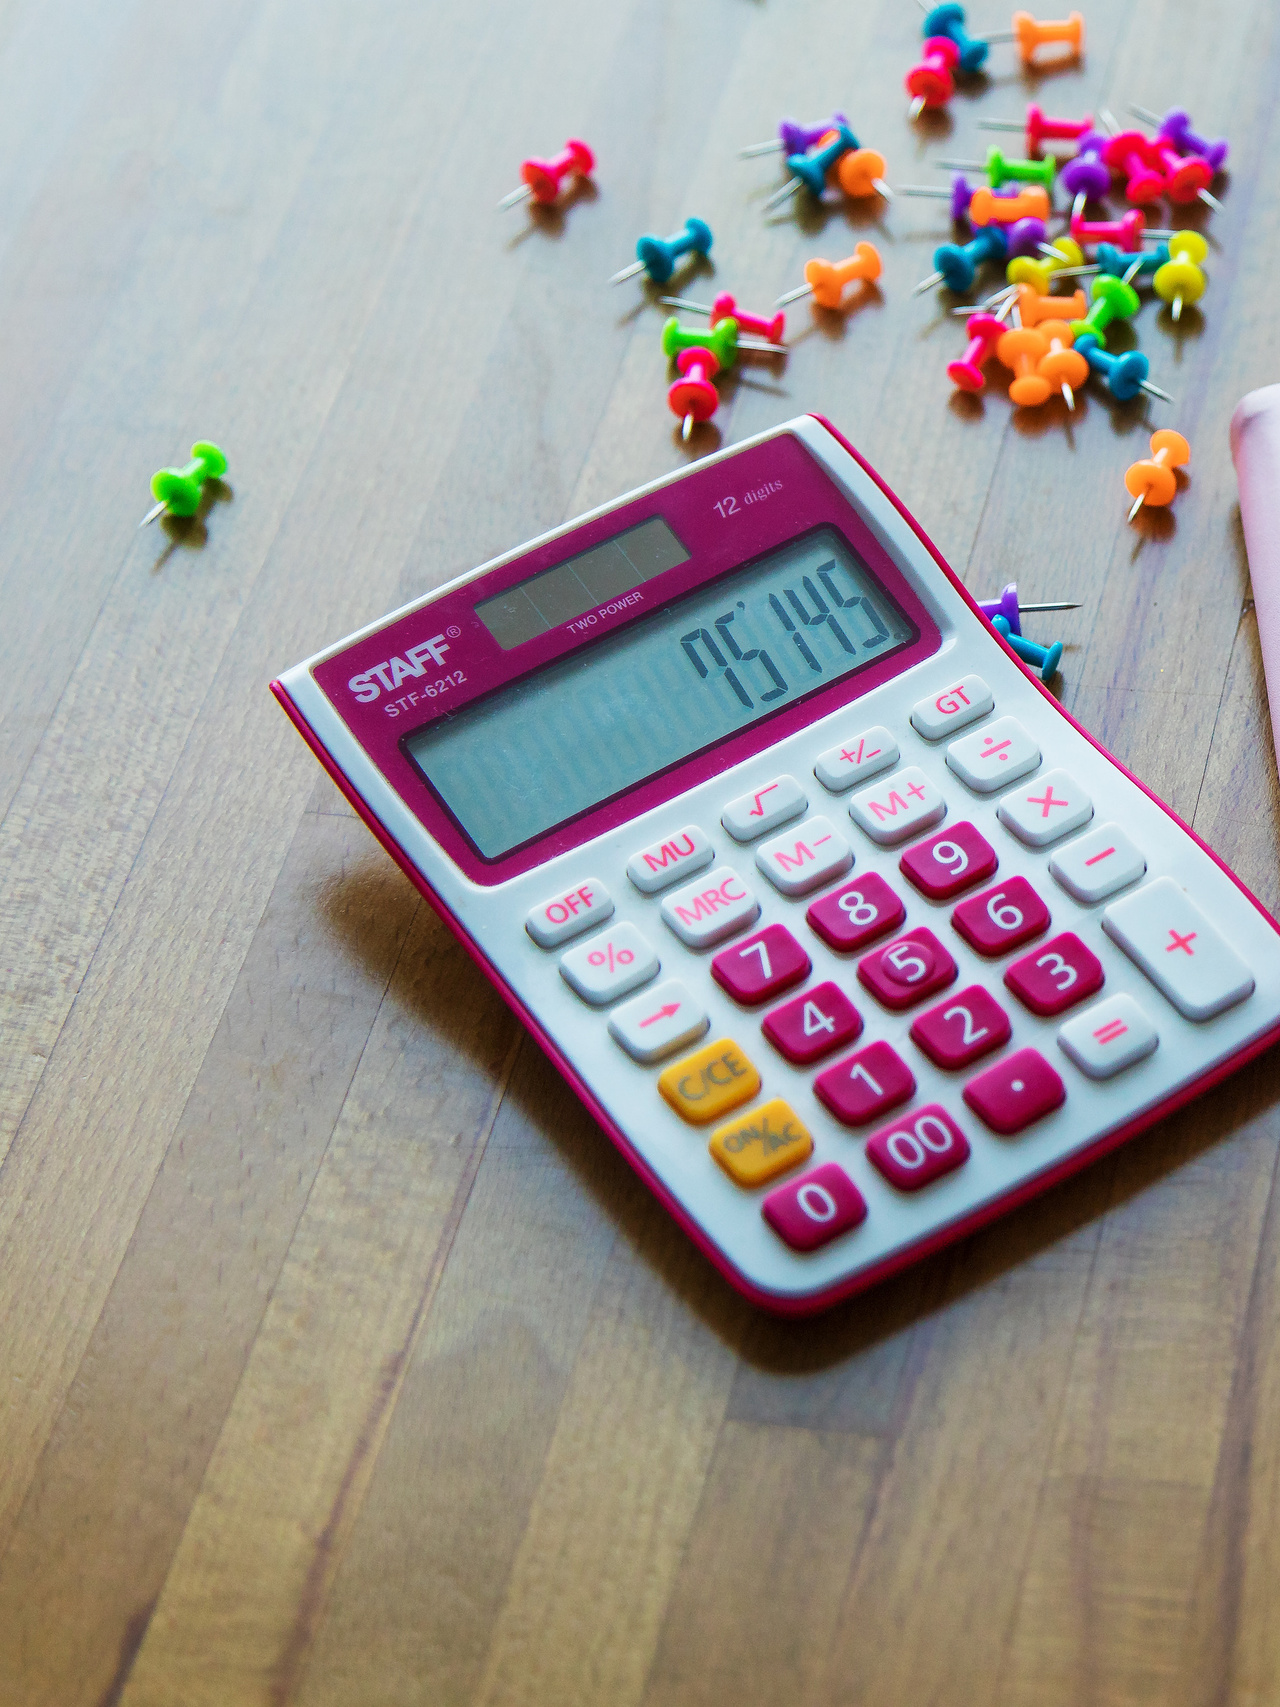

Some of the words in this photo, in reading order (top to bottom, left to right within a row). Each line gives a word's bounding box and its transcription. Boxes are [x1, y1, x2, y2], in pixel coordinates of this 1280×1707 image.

[713, 496, 741, 518] 12
[744, 480, 783, 505] digits
[566, 613, 598, 635] TWO
[598, 591, 645, 619] POWER
[384, 669, 468, 718] STF-6212
[935, 686, 972, 716] GT
[867, 781, 926, 822] M+
[642, 834, 695, 873] MU
[932, 840, 969, 876] 9
[545, 886, 595, 925] OFF
[674, 878, 747, 927] MRC
[838, 891, 878, 928] 8
[986, 893, 1023, 931] 6
[739, 940, 773, 980] 7
[887, 945, 926, 983] 5
[1036, 952, 1077, 991] 3
[803, 1001, 836, 1038] 4
[943, 1006, 988, 1046] 2
[849, 1063, 884, 1097] 1
[886, 1115, 953, 1170] 00
[796, 1183, 837, 1223] 0
